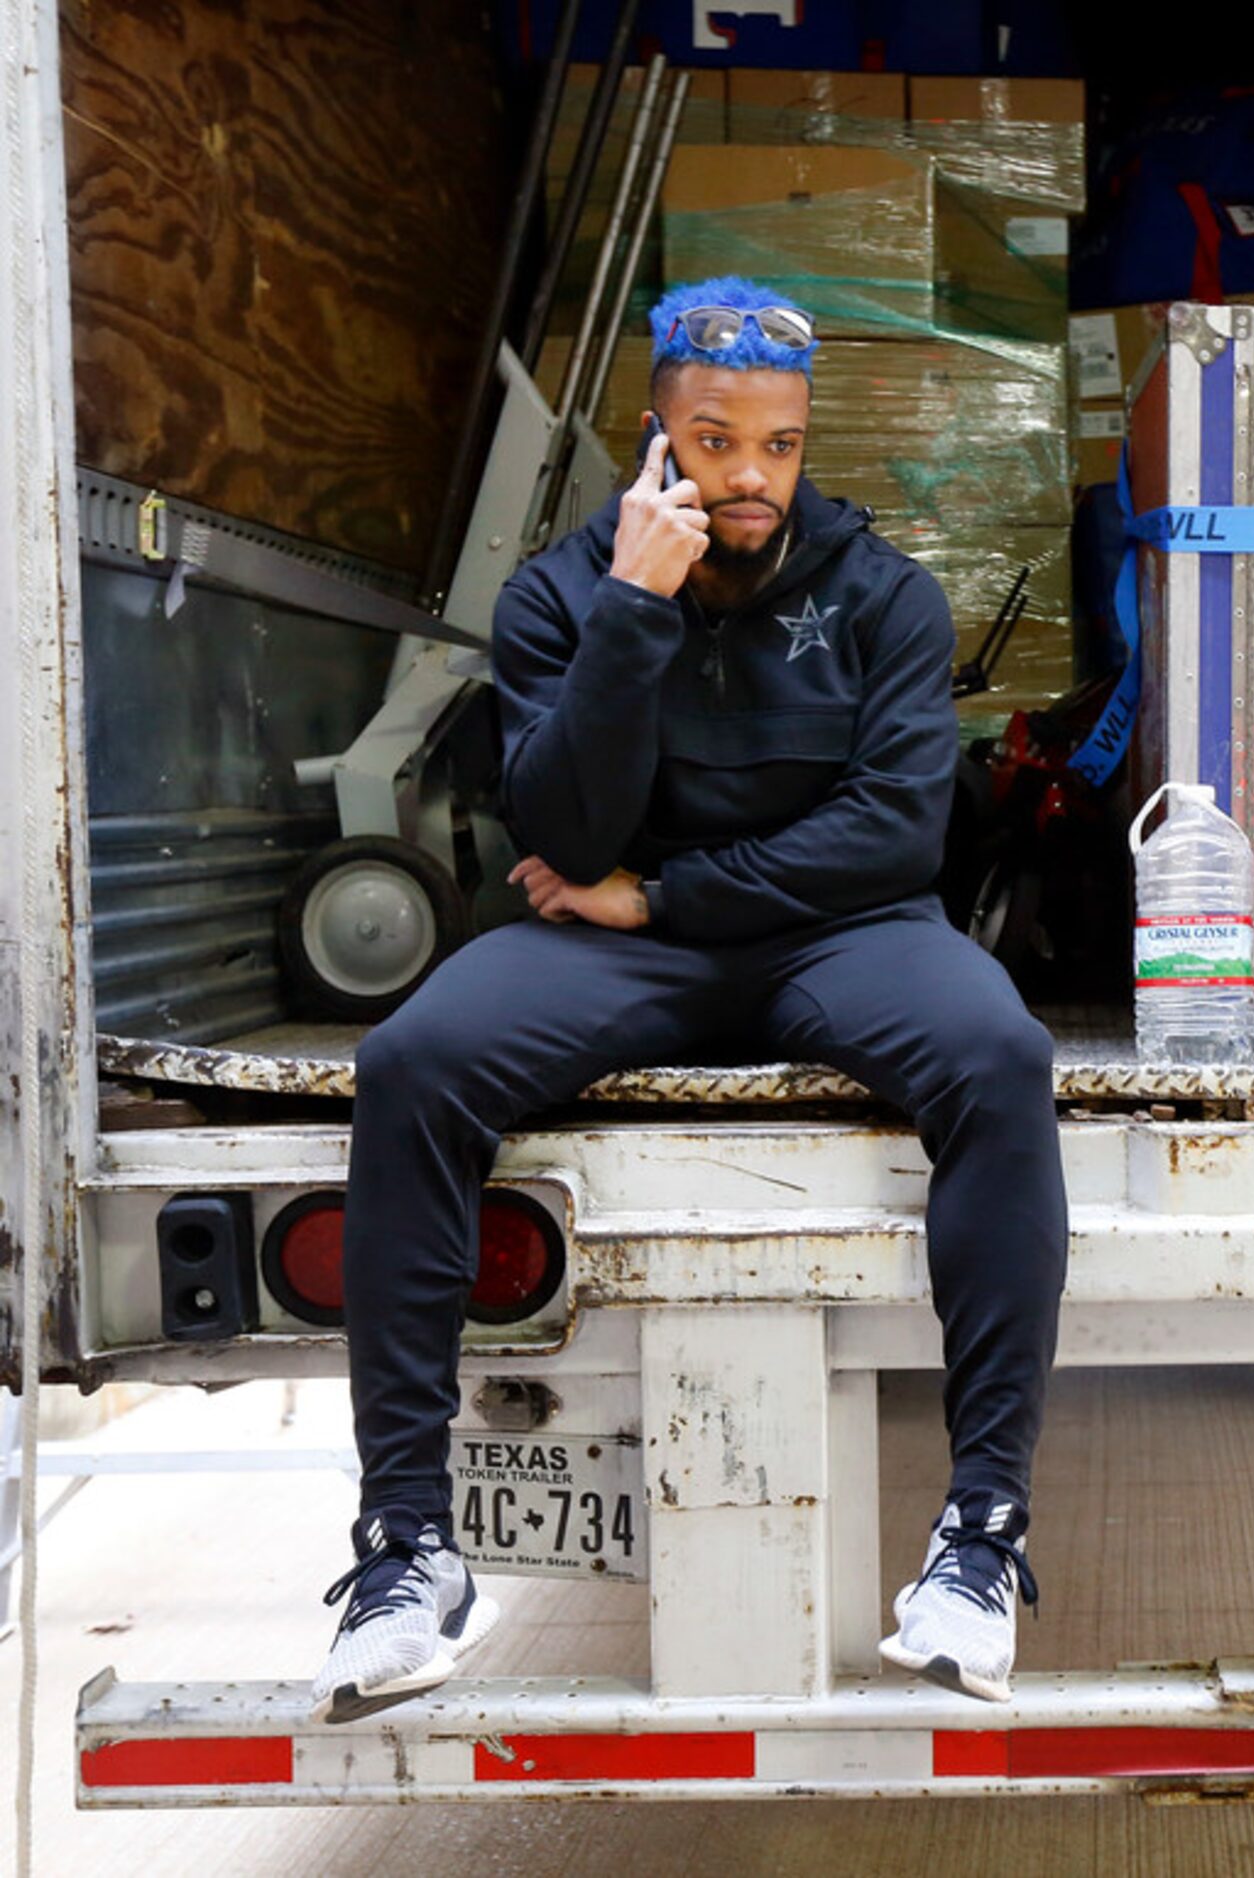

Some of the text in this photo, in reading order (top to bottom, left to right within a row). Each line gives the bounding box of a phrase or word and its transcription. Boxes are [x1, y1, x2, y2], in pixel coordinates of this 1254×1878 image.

[1194, 926, 1239, 939] GEYSER
[463, 1442, 569, 1471] TEXAS
[457, 1467, 574, 1485] TOKEN TRAILER
[461, 1552, 581, 1568] he Lone Star State
